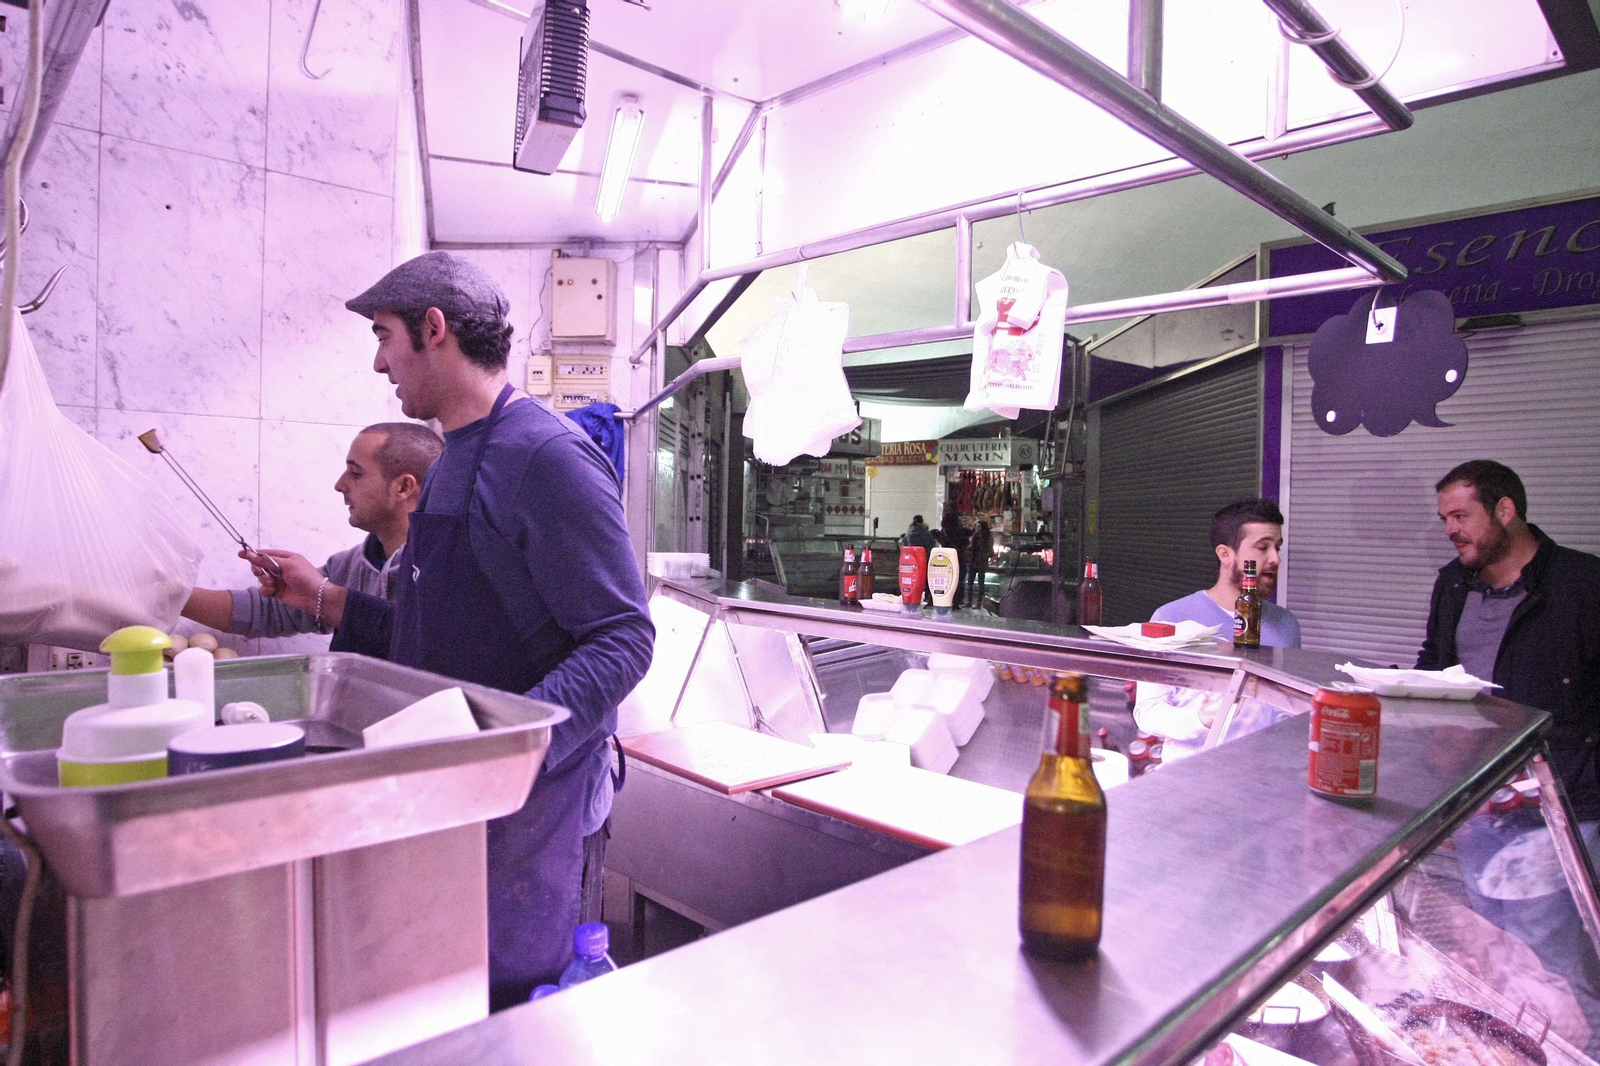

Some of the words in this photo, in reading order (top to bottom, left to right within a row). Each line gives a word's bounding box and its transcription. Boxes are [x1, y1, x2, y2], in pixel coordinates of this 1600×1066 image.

[881, 443, 902, 456] TERIA
[903, 441, 927, 455] ROSA
[940, 442, 1008, 453] CHARCUTERIA
